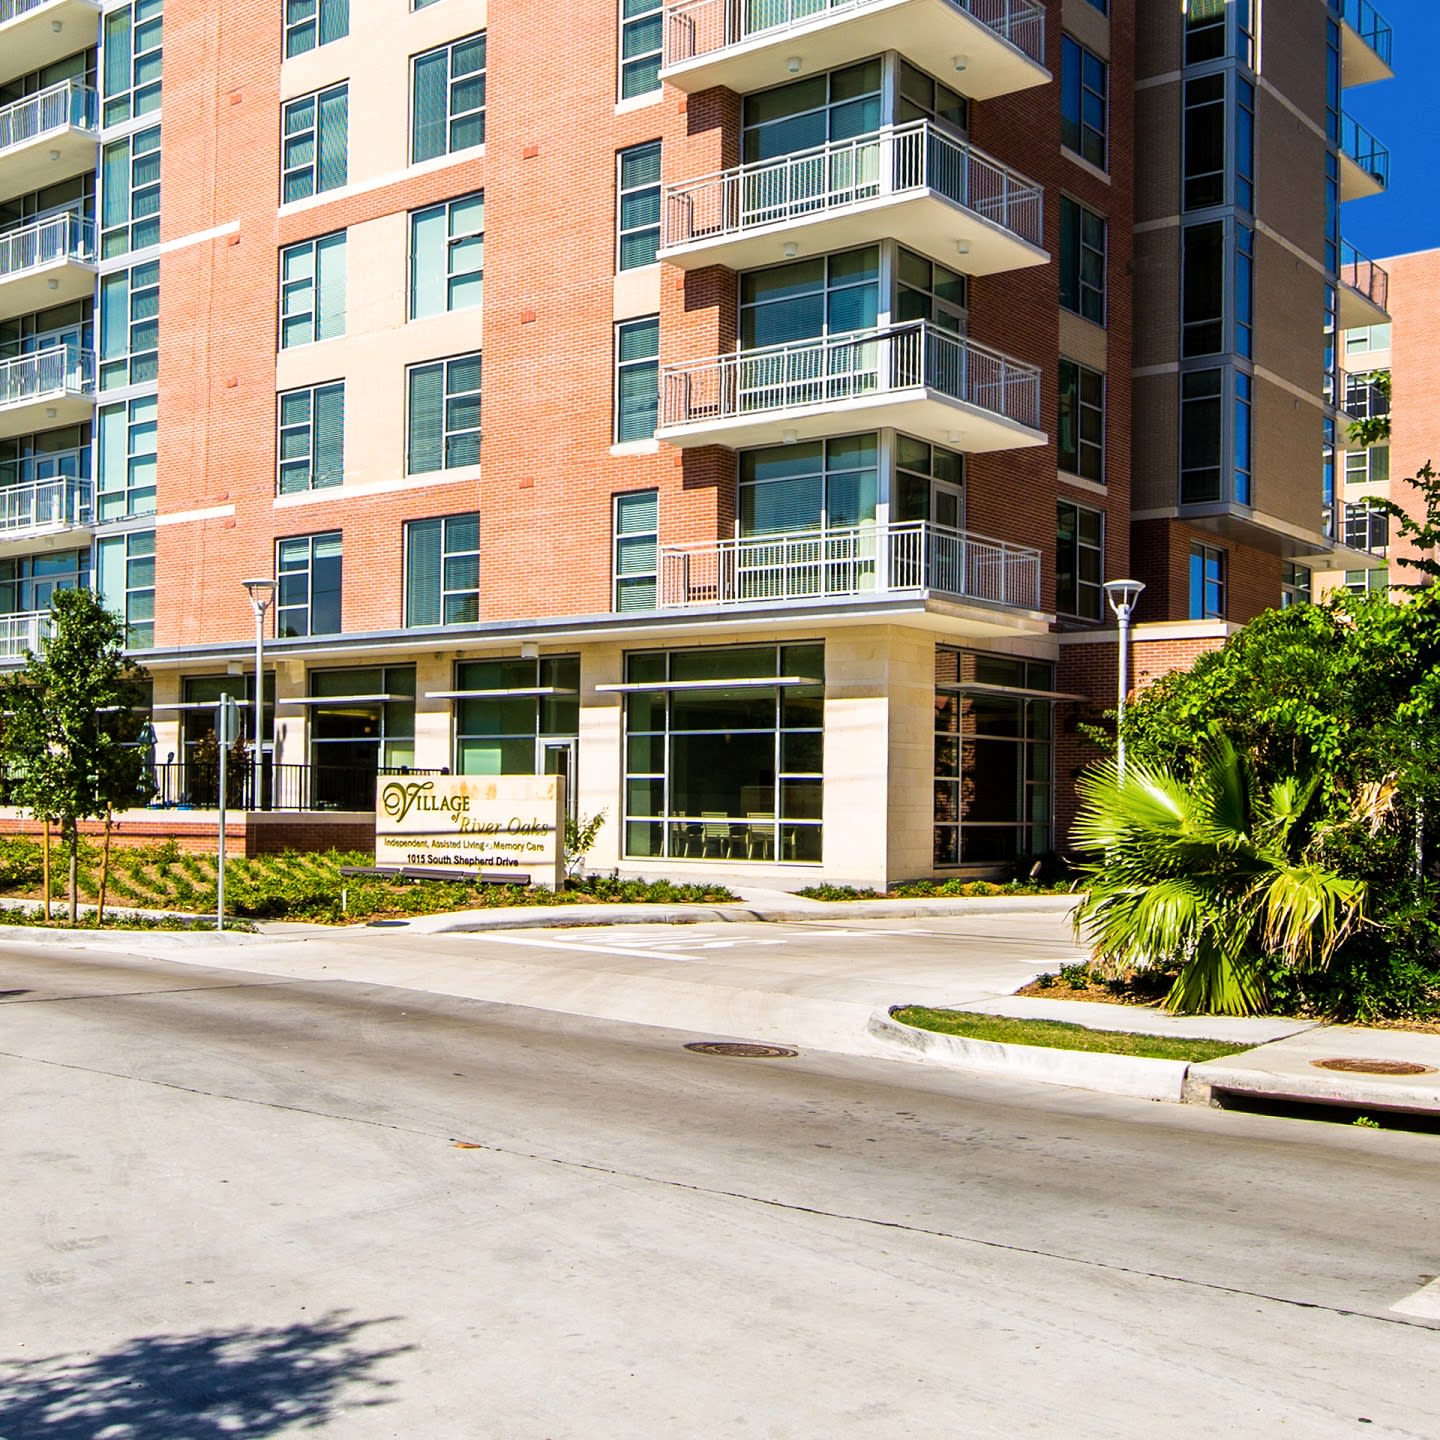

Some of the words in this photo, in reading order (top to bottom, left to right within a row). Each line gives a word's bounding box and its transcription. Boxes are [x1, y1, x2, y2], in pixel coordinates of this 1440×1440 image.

[451, 812, 461, 823] of
[459, 817, 502, 835] River
[507, 817, 549, 836] Oaks
[432, 840, 461, 849] Assisted
[463, 840, 485, 851] Living
[493, 841, 524, 853] Memory
[526, 841, 545, 852] Care
[407, 854, 426, 864] 1015
[427, 854, 452, 865] South
[453, 855, 494, 867] Shepherd
[496, 856, 520, 867] Drive
